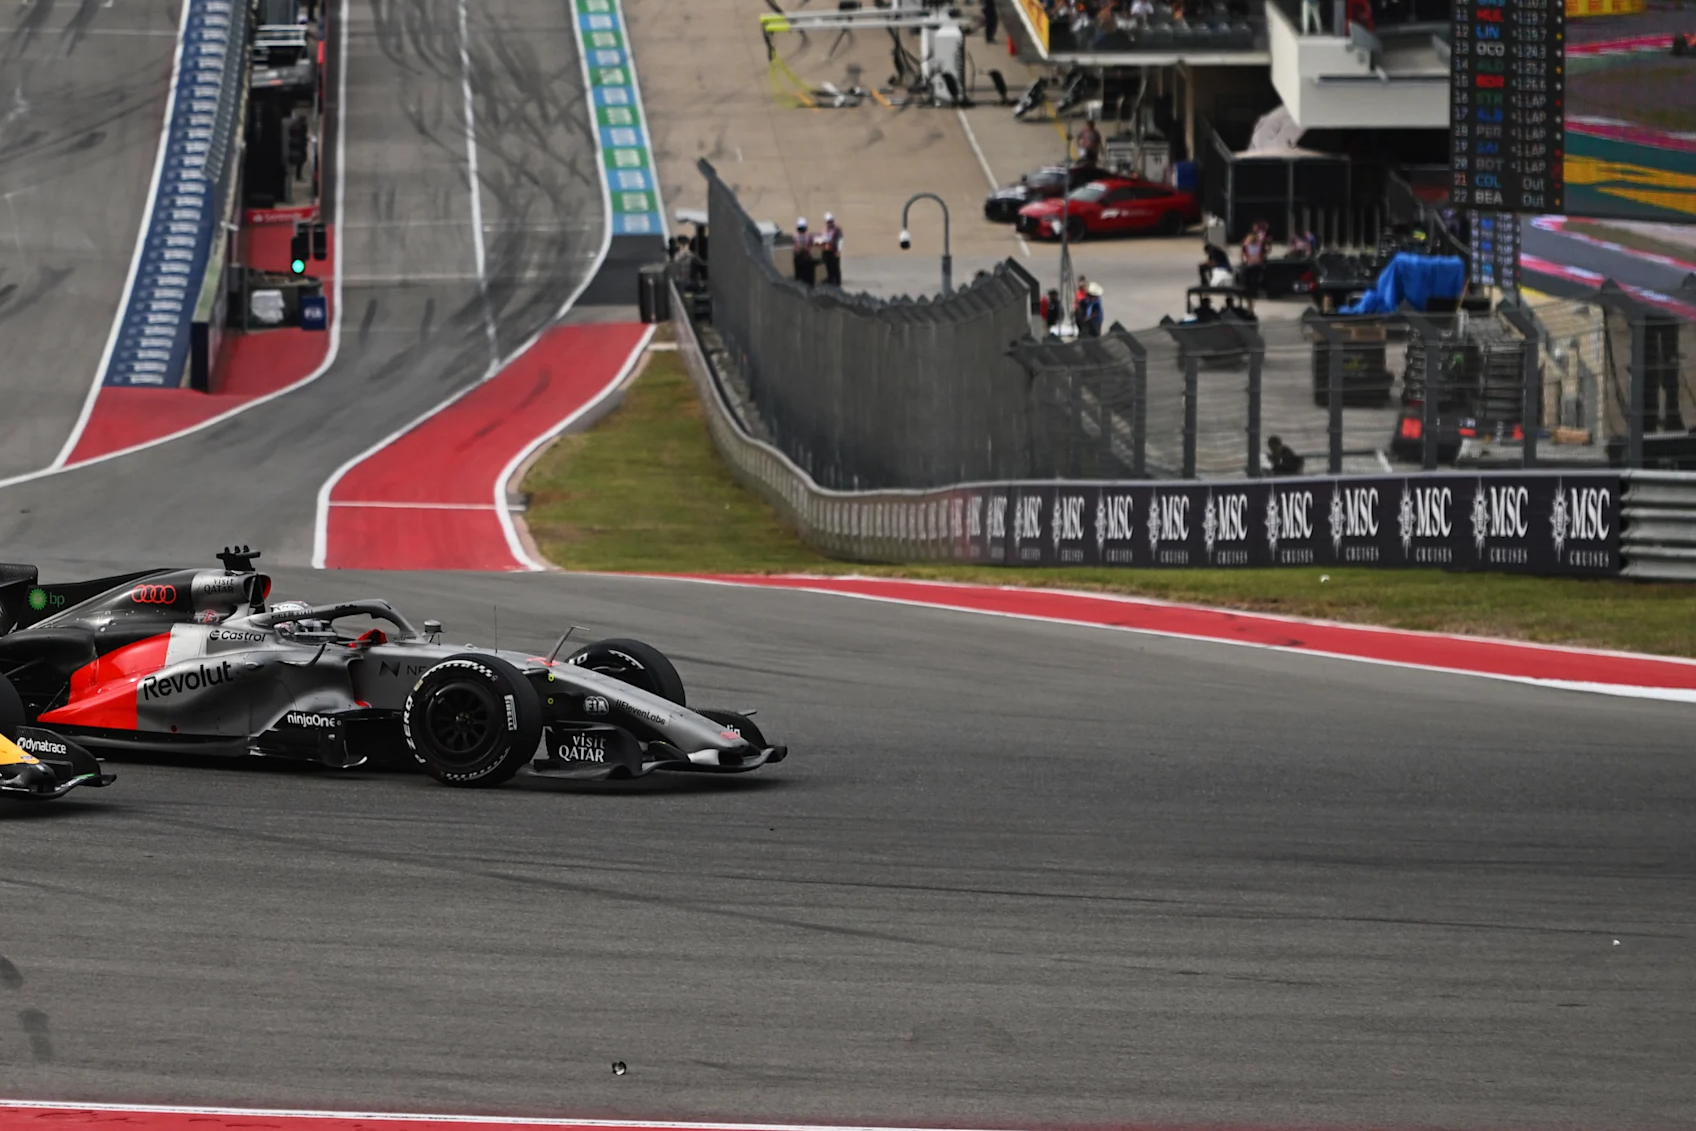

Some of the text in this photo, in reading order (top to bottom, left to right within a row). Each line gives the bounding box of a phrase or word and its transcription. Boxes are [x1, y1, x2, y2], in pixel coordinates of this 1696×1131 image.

[1476, 25, 1500, 39] LIN
[1476, 41, 1505, 56] OCO
[1523, 176, 1544, 190] Out
[1475, 190, 1503, 205] BEA
[1523, 193, 1544, 207] Out
[1022, 496, 1042, 538] MSC
[1062, 496, 1084, 540] MSC
[1107, 495, 1133, 541] MSC
[1161, 495, 1189, 541] MSC
[1218, 494, 1248, 541] MSC
[1281, 491, 1313, 539] MSC
[1345, 488, 1379, 537] MSC
[1416, 487, 1452, 537] MSC
[1490, 486, 1529, 538] MSC
[1570, 488, 1610, 540] MSC
[1569, 551, 1609, 567] CRUISES
[204, 584, 235, 595] QATAR
[213, 577, 234, 586] visit
[49, 590, 66, 607] bp
[221, 630, 266, 642] Castrol
[143, 661, 233, 701] Revolut
[504, 694, 517, 731] PIRELLI
[585, 699, 608, 713] FIA
[287, 712, 336, 728] ninjaOne
[403, 694, 416, 751] ZERO
[25, 738, 67, 755] dynatrace
[572, 732, 606, 749] visit
[558, 744, 605, 763] QATAR
